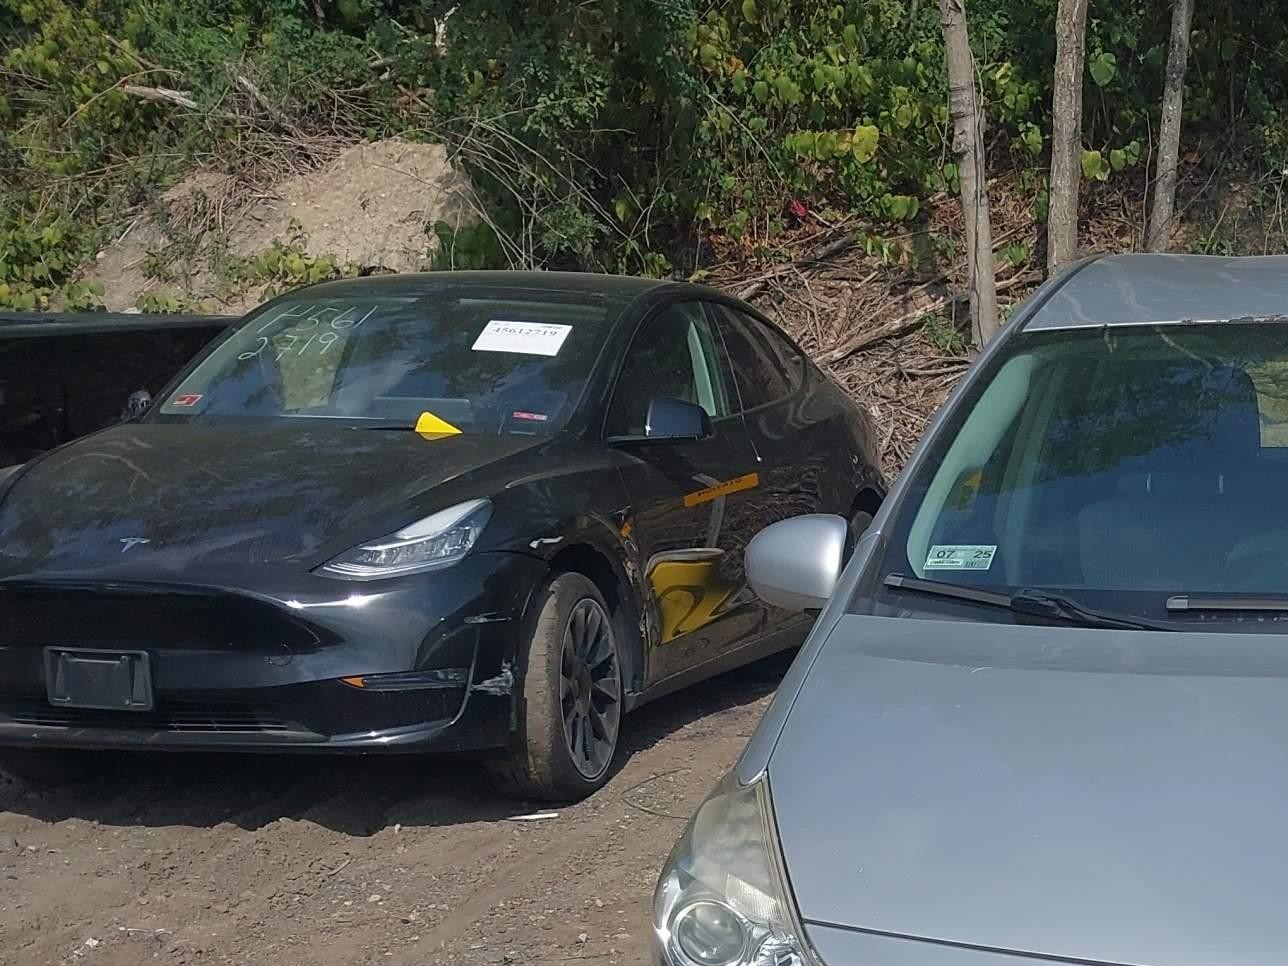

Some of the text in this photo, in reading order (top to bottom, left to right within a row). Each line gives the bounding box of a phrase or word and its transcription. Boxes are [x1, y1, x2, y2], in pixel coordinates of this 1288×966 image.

[256, 304, 379, 334] 4561
[238, 332, 340, 361] 2719
[936, 550, 992, 559] 07 25
